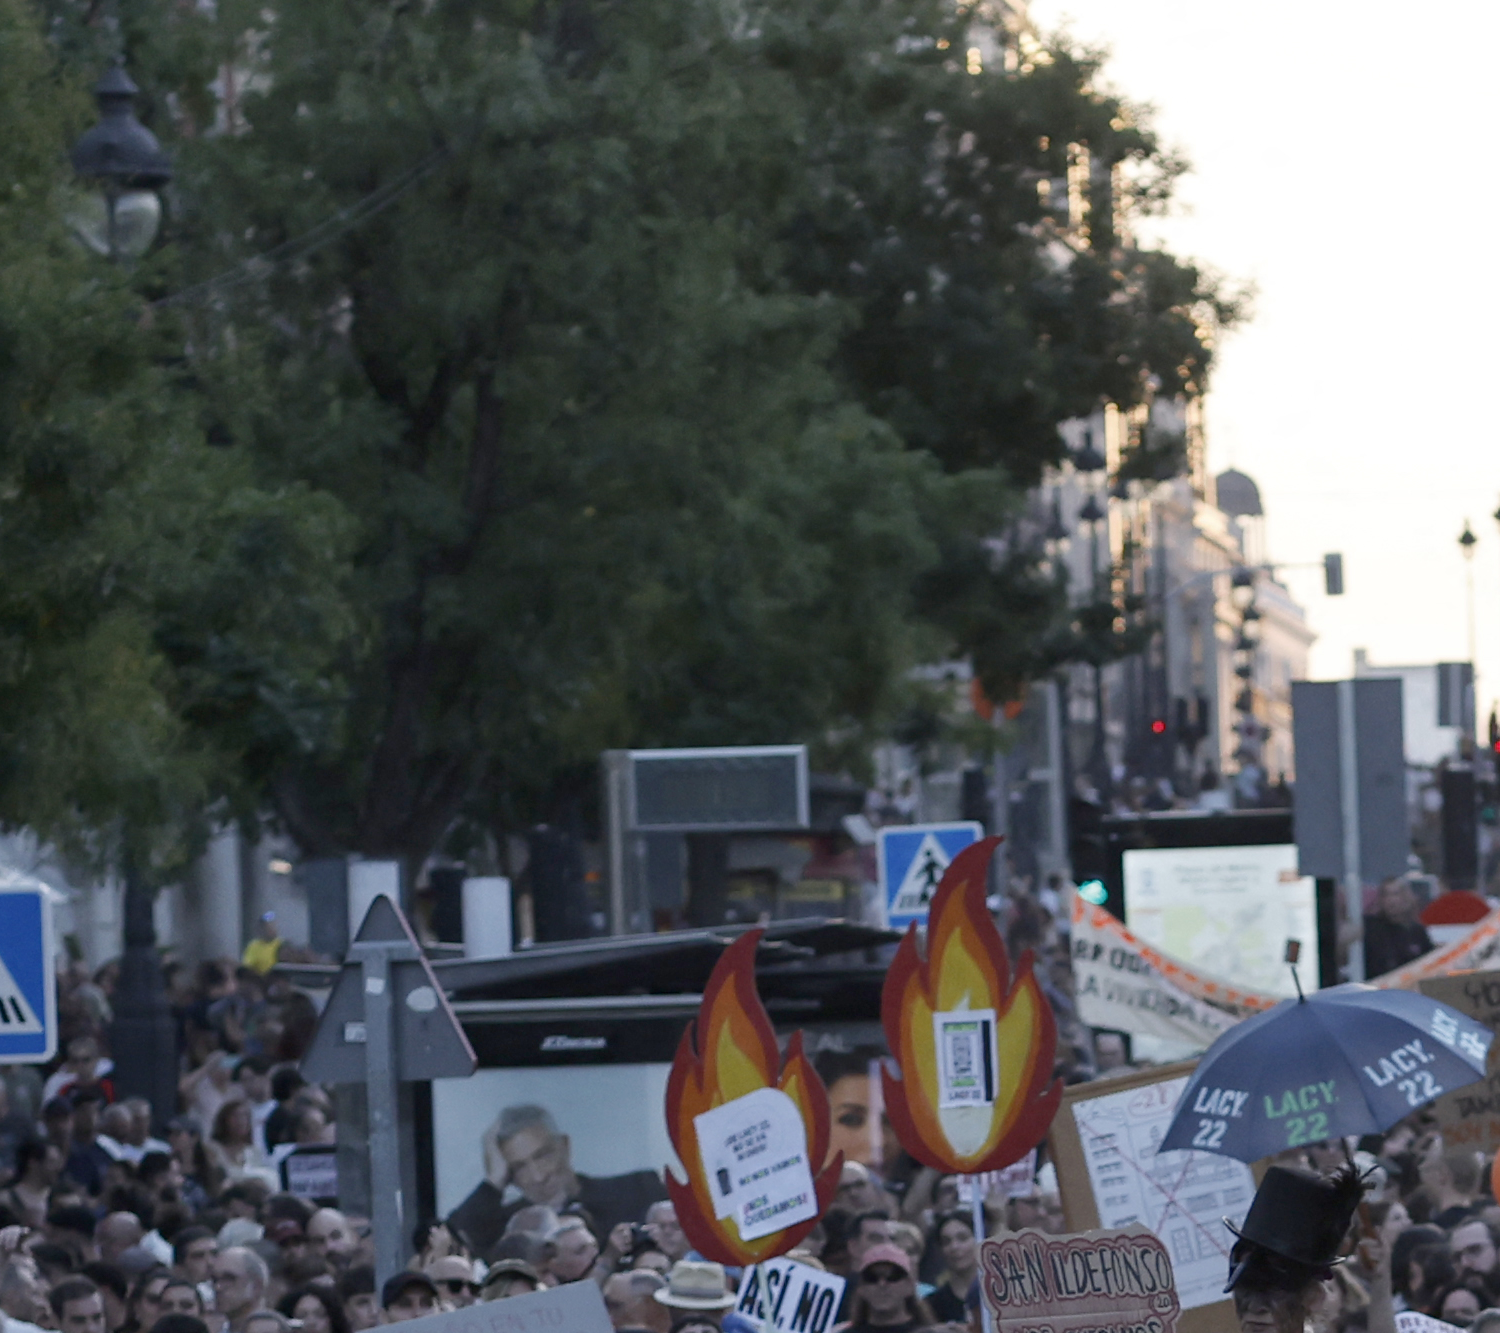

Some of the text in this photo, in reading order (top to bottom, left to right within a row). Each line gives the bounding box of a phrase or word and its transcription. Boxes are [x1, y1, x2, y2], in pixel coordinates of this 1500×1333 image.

[1363, 1039, 1435, 1088] LACY.
[1397, 1070, 1444, 1107] 22
[1191, 1118, 1228, 1148] 22
[1284, 1112, 1330, 1147] 22
[990, 1242, 1172, 1302] SAN ILDEFONSO
